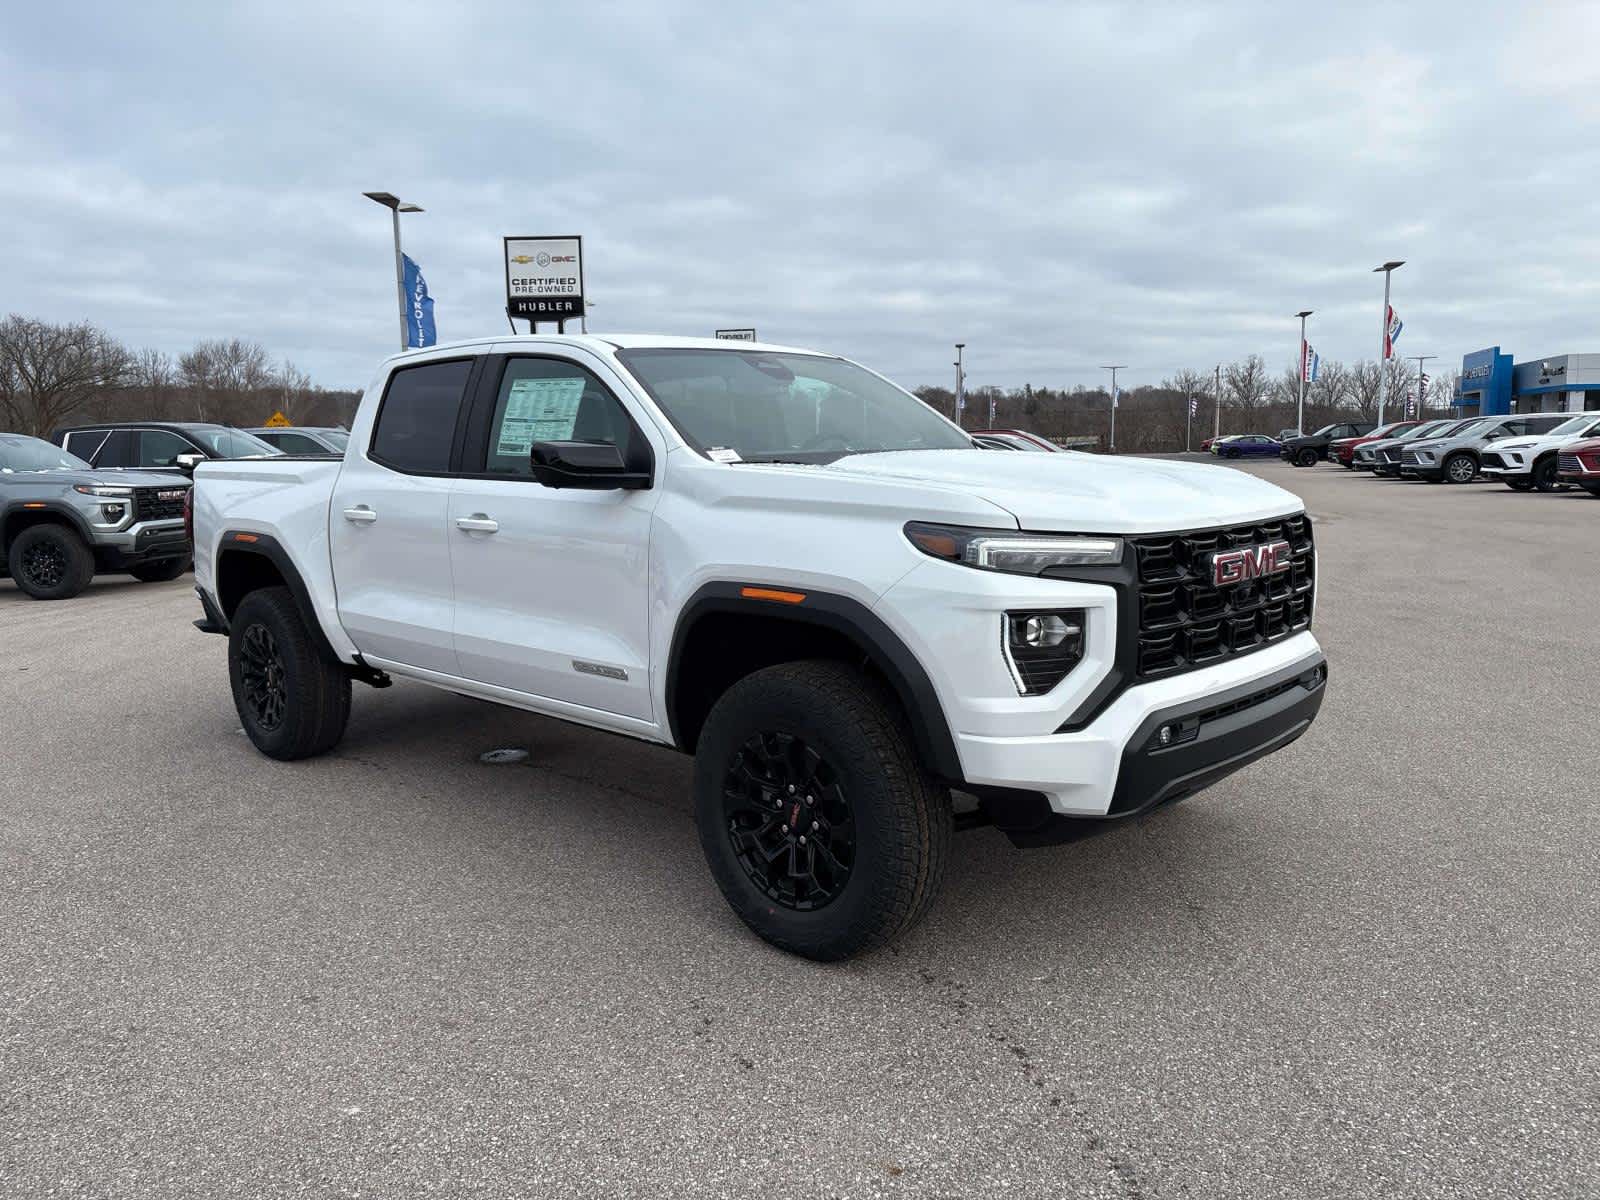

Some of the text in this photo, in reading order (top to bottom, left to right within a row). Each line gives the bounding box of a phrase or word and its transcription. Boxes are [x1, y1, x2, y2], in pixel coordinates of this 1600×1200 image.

[511, 278, 577, 286] CERTIFIED
[414, 271, 426, 348] HEVROLET
[519, 302, 573, 312] HUBLER
[1213, 541, 1291, 587] GMC
